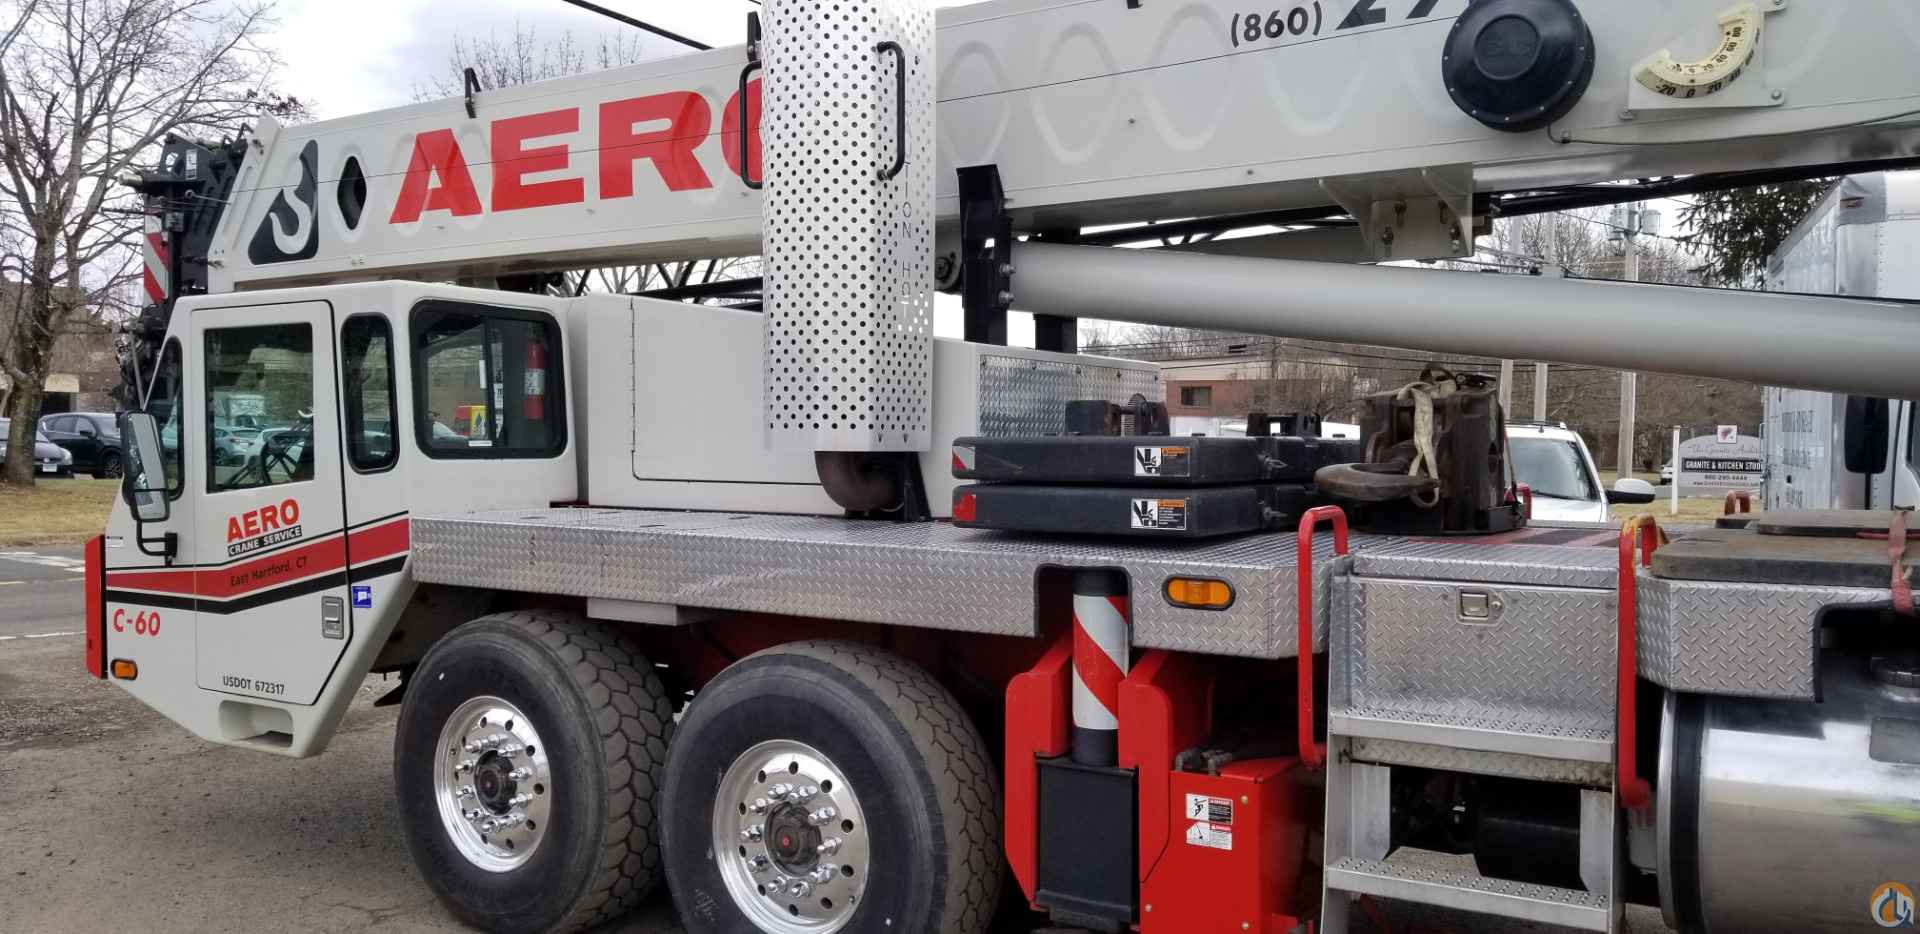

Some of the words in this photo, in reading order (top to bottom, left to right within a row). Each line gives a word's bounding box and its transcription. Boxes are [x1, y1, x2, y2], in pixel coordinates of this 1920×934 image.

[1230, 0, 1322, 48] (860)
[1685, 460, 1710, 470] GRANITE
[1711, 460, 1717, 470] &
[1718, 460, 1744, 470] KITCHEN
[227, 498, 300, 543] AERO
[229, 540, 260, 556] CRANE
[263, 526, 302, 546] SERVICE
[231, 574, 249, 587] East
[113, 608, 161, 637] C-60
[223, 675, 252, 690] USDOT
[255, 680, 285, 696] 672317
